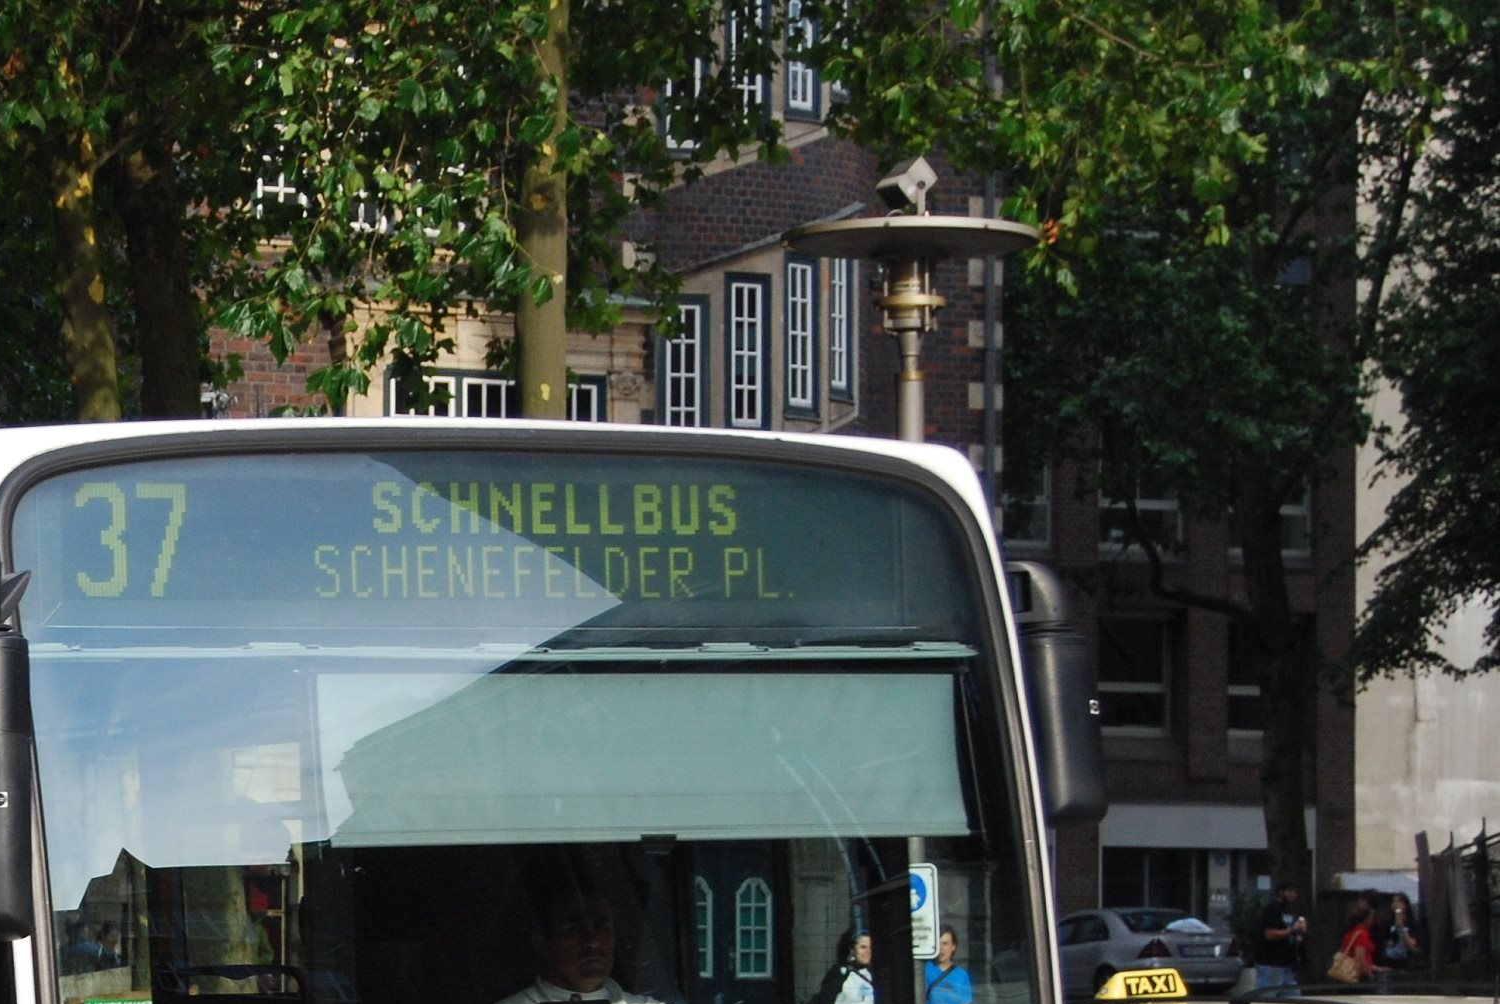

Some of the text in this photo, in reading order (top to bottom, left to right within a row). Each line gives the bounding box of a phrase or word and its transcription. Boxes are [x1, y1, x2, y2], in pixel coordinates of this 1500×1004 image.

[373, 483, 738, 535] SCHNELLBUS
[75, 483, 187, 597] 37
[314, 546, 796, 599] SCHENEFELDER PL.
[1125, 974, 1175, 995] TAXI
